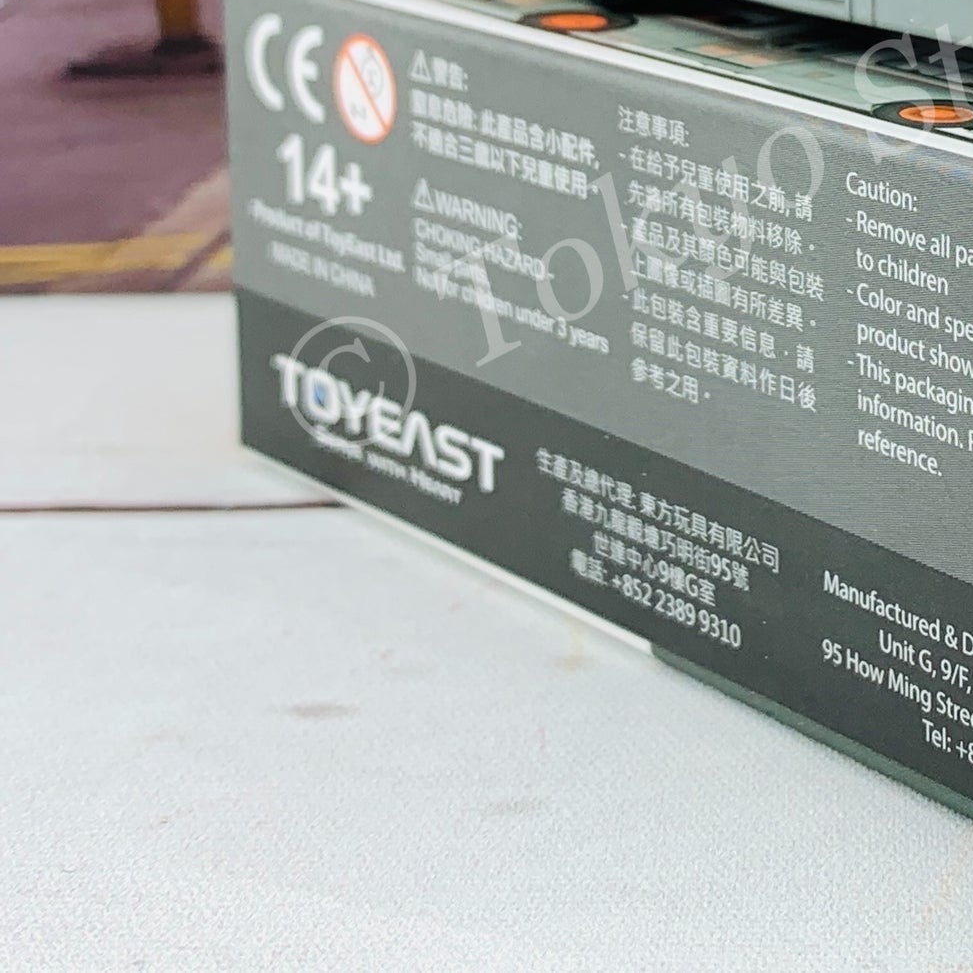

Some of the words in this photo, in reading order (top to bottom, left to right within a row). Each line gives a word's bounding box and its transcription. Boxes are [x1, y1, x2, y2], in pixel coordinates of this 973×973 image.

[276, 133, 373, 217] 14+
[845, 171, 918, 212] Caution:
[433, 198, 522, 241] WARNING:
[856, 211, 927, 252] Remove
[930, 234, 950, 259] all
[856, 248, 874, 273] to
[878, 254, 949, 296] children
[857, 283, 902, 317] Color
[906, 300, 940, 329] and
[556, 316, 569, 339] 3
[569, 325, 610, 355] years
[857, 323, 926, 364] product
[856, 354, 891, 385] This
[271, 353, 505, 493] TOYEAST
[857, 388, 964, 449] information.
[857, 427, 943, 478] reference.
[639, 492, 781, 573] 東方玩具有限公司
[611, 570, 652, 607] +852
[655, 587, 697, 627] 2389
[699, 608, 742, 649] 9310
[823, 570, 940, 643] Manufactured
[945, 625, 959, 650] &
[822, 638, 843, 665] 95
[846, 651, 885, 685] How
[888, 668, 932, 712] Ming
[879, 629, 916, 667] Unit
[918, 649, 937, 679] G,
[940, 656, 972, 694] 9/F,
[922, 718, 952, 754] Tel:
